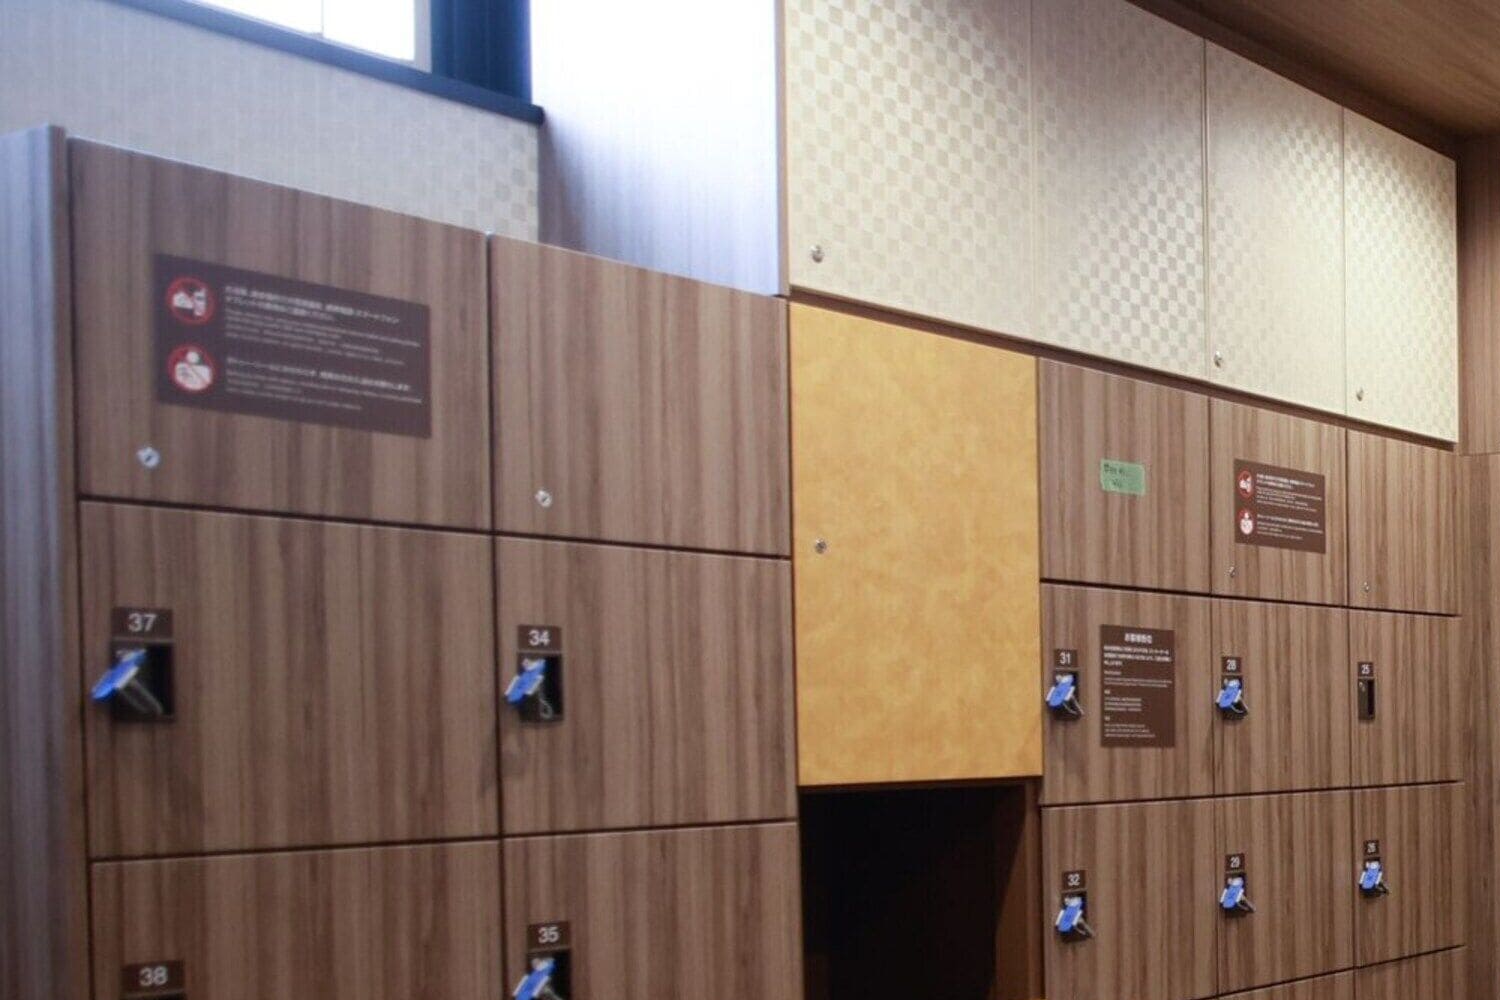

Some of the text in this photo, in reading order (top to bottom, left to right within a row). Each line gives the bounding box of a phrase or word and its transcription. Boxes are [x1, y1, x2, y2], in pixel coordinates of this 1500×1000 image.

[128, 612, 157, 632] 37
[528, 629, 551, 646] 34
[1059, 651, 1071, 665] 31
[1067, 873, 1081, 887] 32
[538, 926, 560, 944] 35
[140, 965, 168, 987] 38
